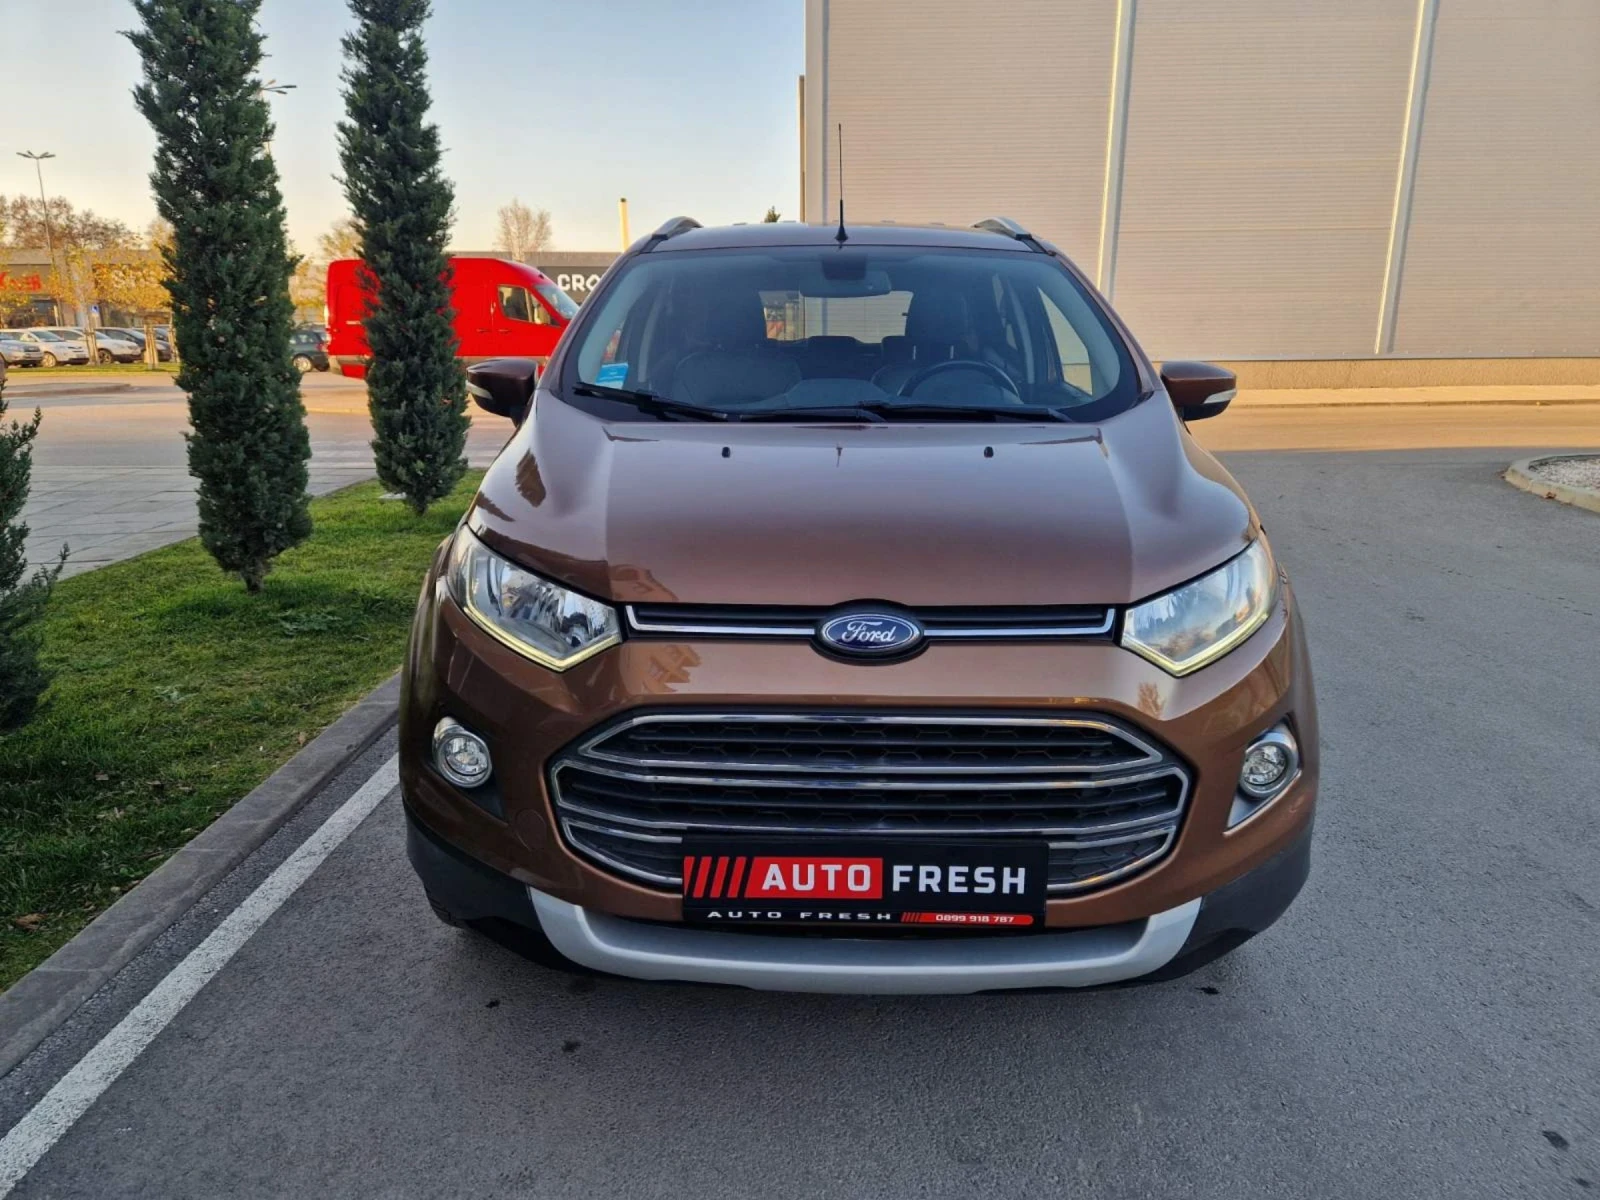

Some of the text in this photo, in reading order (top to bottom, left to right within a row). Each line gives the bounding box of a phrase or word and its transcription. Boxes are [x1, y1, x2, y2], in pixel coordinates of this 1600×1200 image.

[841, 620, 897, 642] Ford
[761, 863, 1026, 895] AUTO FRESH
[707, 911, 891, 920] AUTO FRESH
[935, 914, 1015, 923] 0899 918 787
